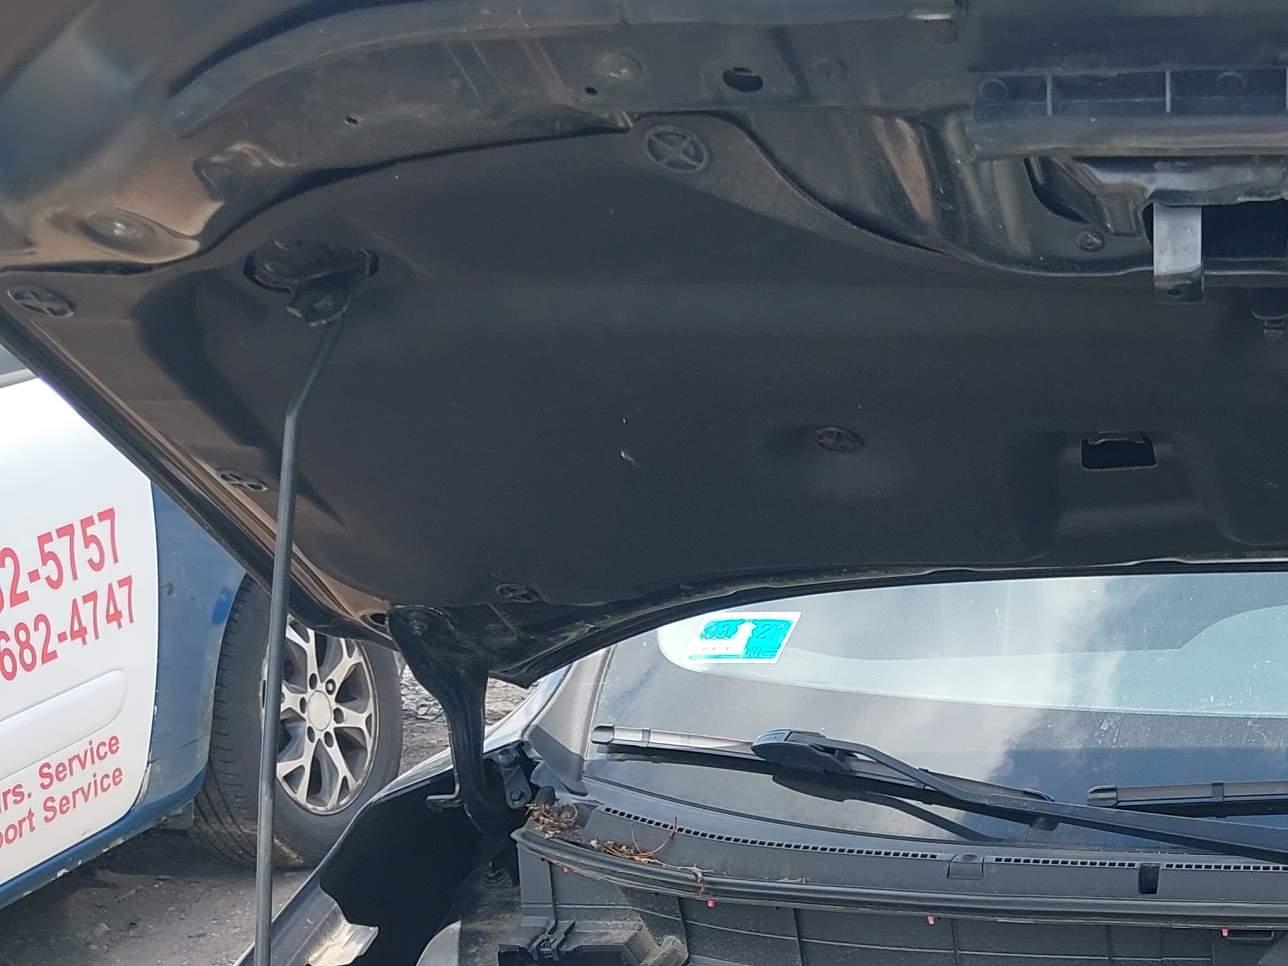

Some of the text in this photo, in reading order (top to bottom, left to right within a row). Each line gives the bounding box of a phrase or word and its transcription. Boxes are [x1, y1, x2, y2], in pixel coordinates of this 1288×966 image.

[0, 507, 119, 614] 2-5757
[0, 735, 120, 814] rs. Service
[43, 767, 123, 823] Service
